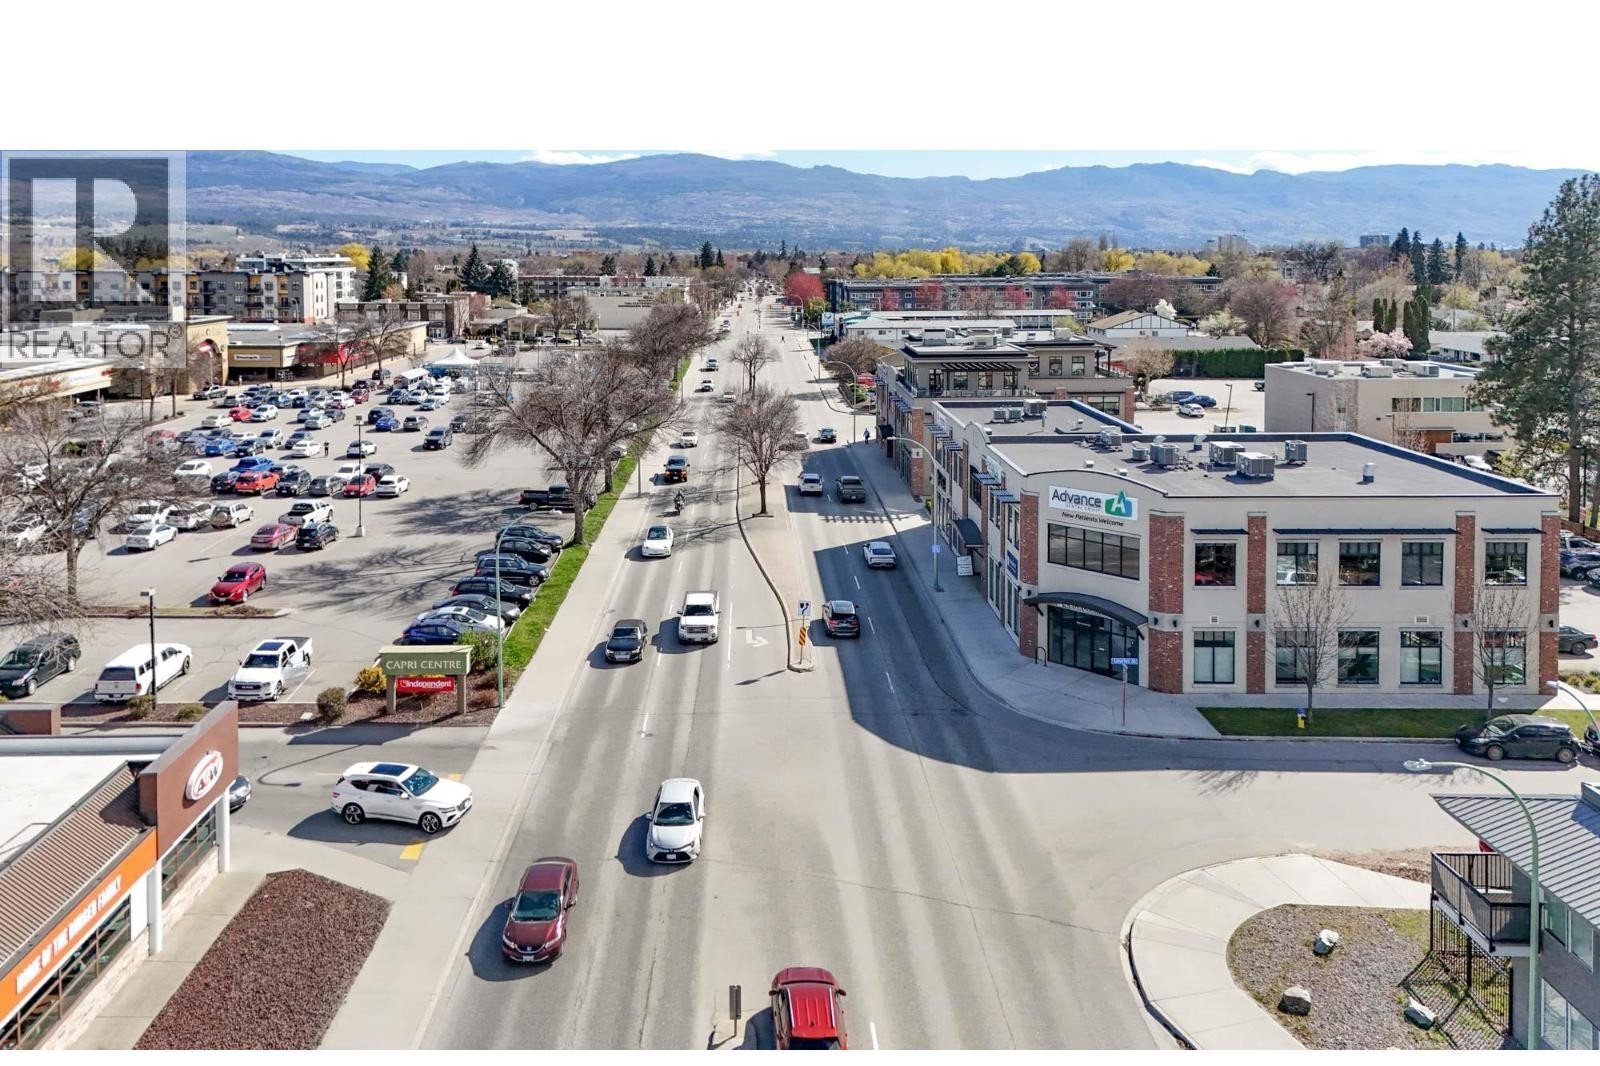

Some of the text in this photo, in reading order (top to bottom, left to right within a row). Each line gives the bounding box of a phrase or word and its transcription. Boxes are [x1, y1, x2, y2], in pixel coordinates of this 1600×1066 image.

[1052, 489, 1102, 508] Advance
[1062, 511, 1124, 527] New Patients Welcome
[385, 660, 462, 670] CAPRI CENTRE
